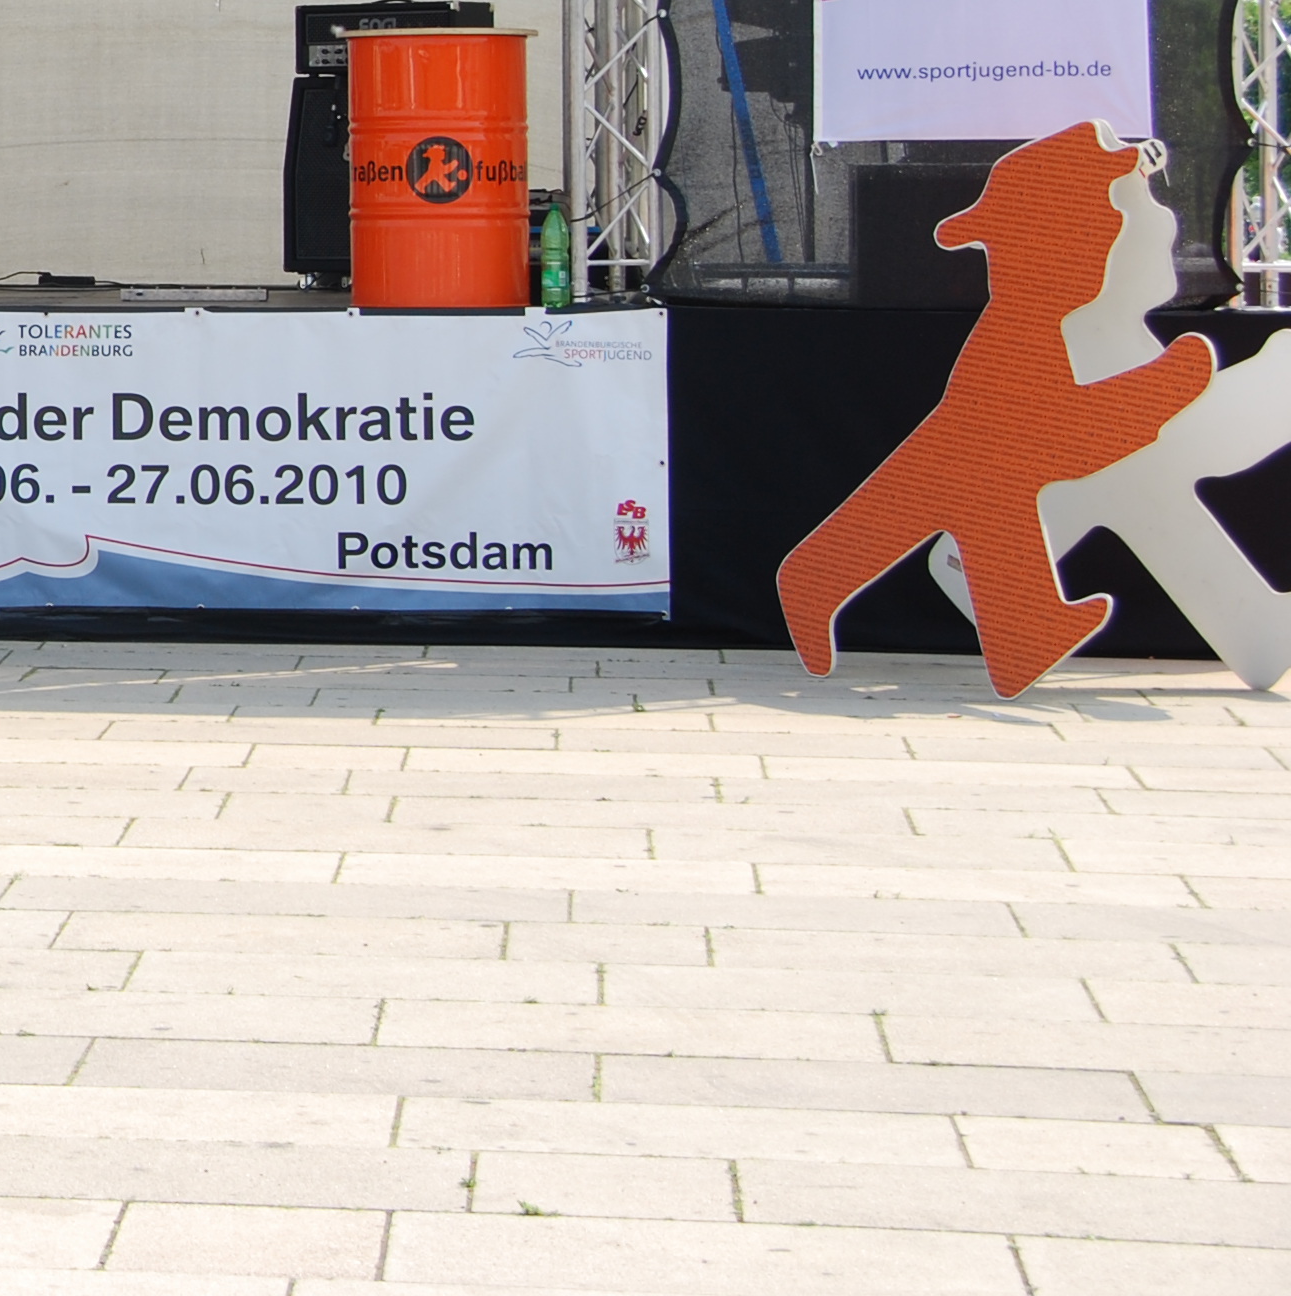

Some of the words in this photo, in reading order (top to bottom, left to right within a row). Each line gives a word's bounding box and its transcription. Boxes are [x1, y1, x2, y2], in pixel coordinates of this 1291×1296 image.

[856, 60, 1113, 83] www.sportjugend-bb.de
[18, 324, 132, 339] TOLERANTES
[19, 345, 133, 357] BRANDENBURG
[555, 340, 643, 349] BRANDENBURGISCHE
[564, 349, 653, 362] SPORTJUGEND
[110, 390, 476, 443] Demokratie
[105, 462, 408, 506] 27.06.2010
[336, 528, 553, 572] Potsdam
